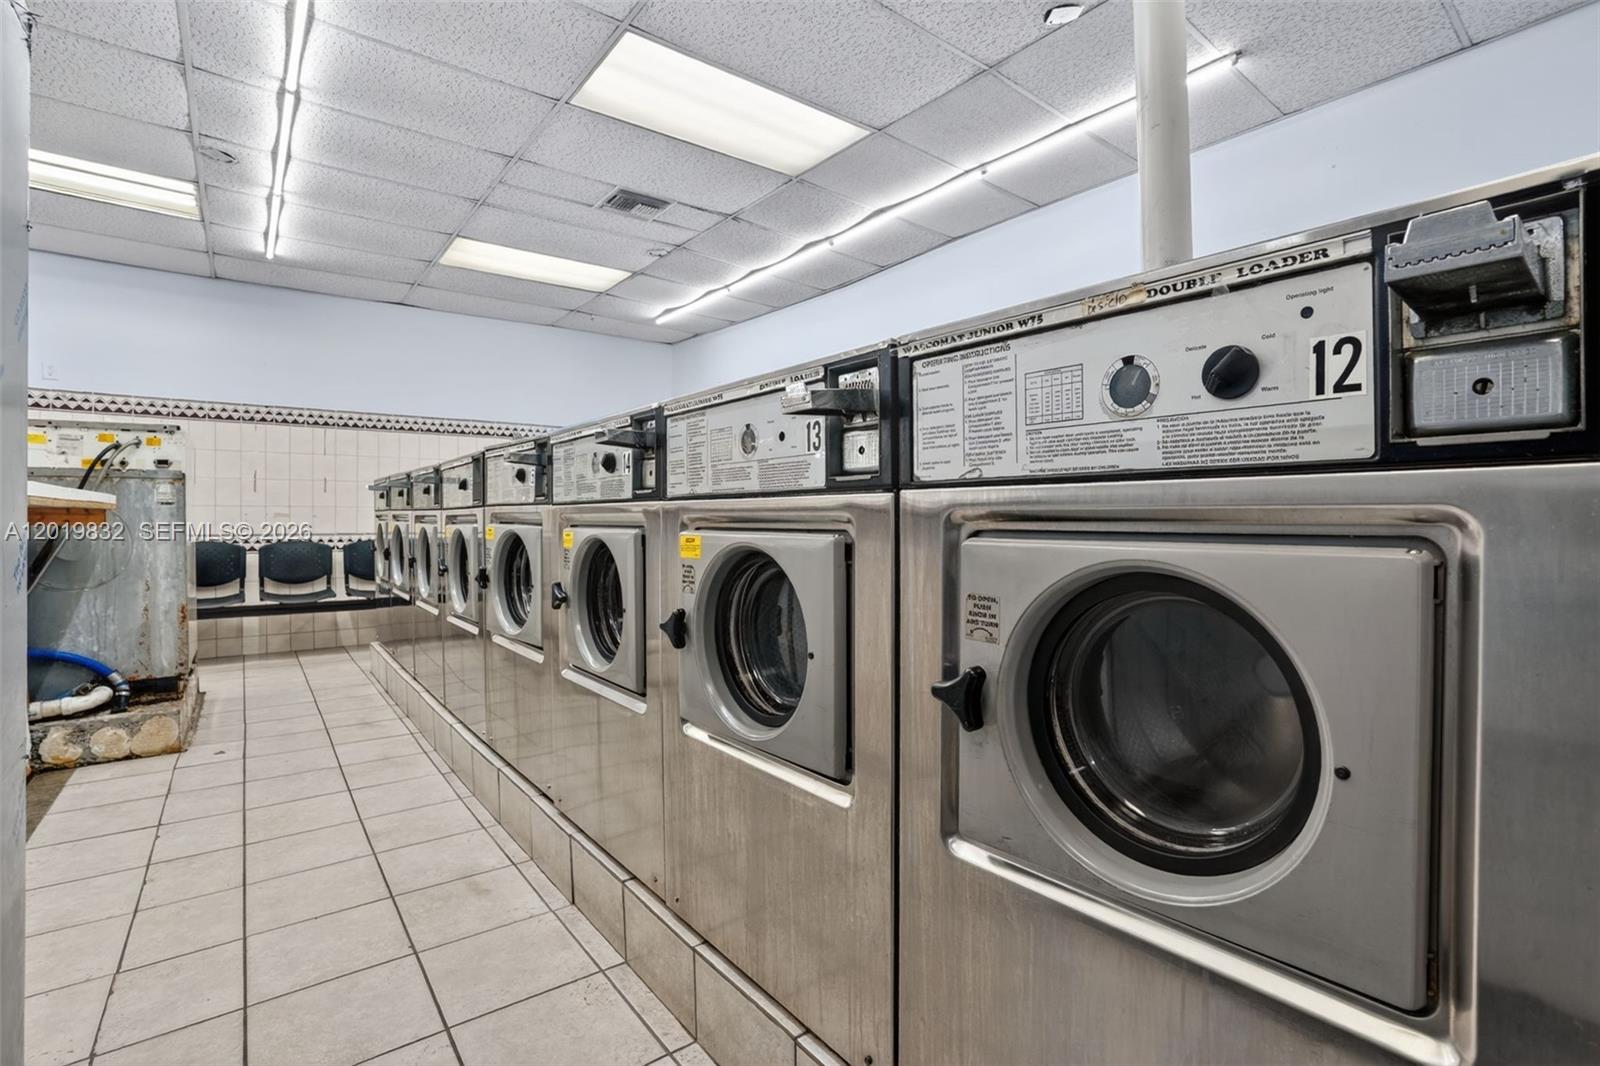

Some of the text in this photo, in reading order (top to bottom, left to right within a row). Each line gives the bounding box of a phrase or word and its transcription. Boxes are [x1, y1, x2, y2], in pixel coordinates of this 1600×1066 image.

[1146, 247, 1331, 298] DOUBLE LOADER
[1285, 286, 1334, 301] Operating light
[902, 314, 1044, 354] WASCOMAT JUNIOR W75
[1312, 335, 1363, 396] 12
[806, 420, 822, 452] 13
